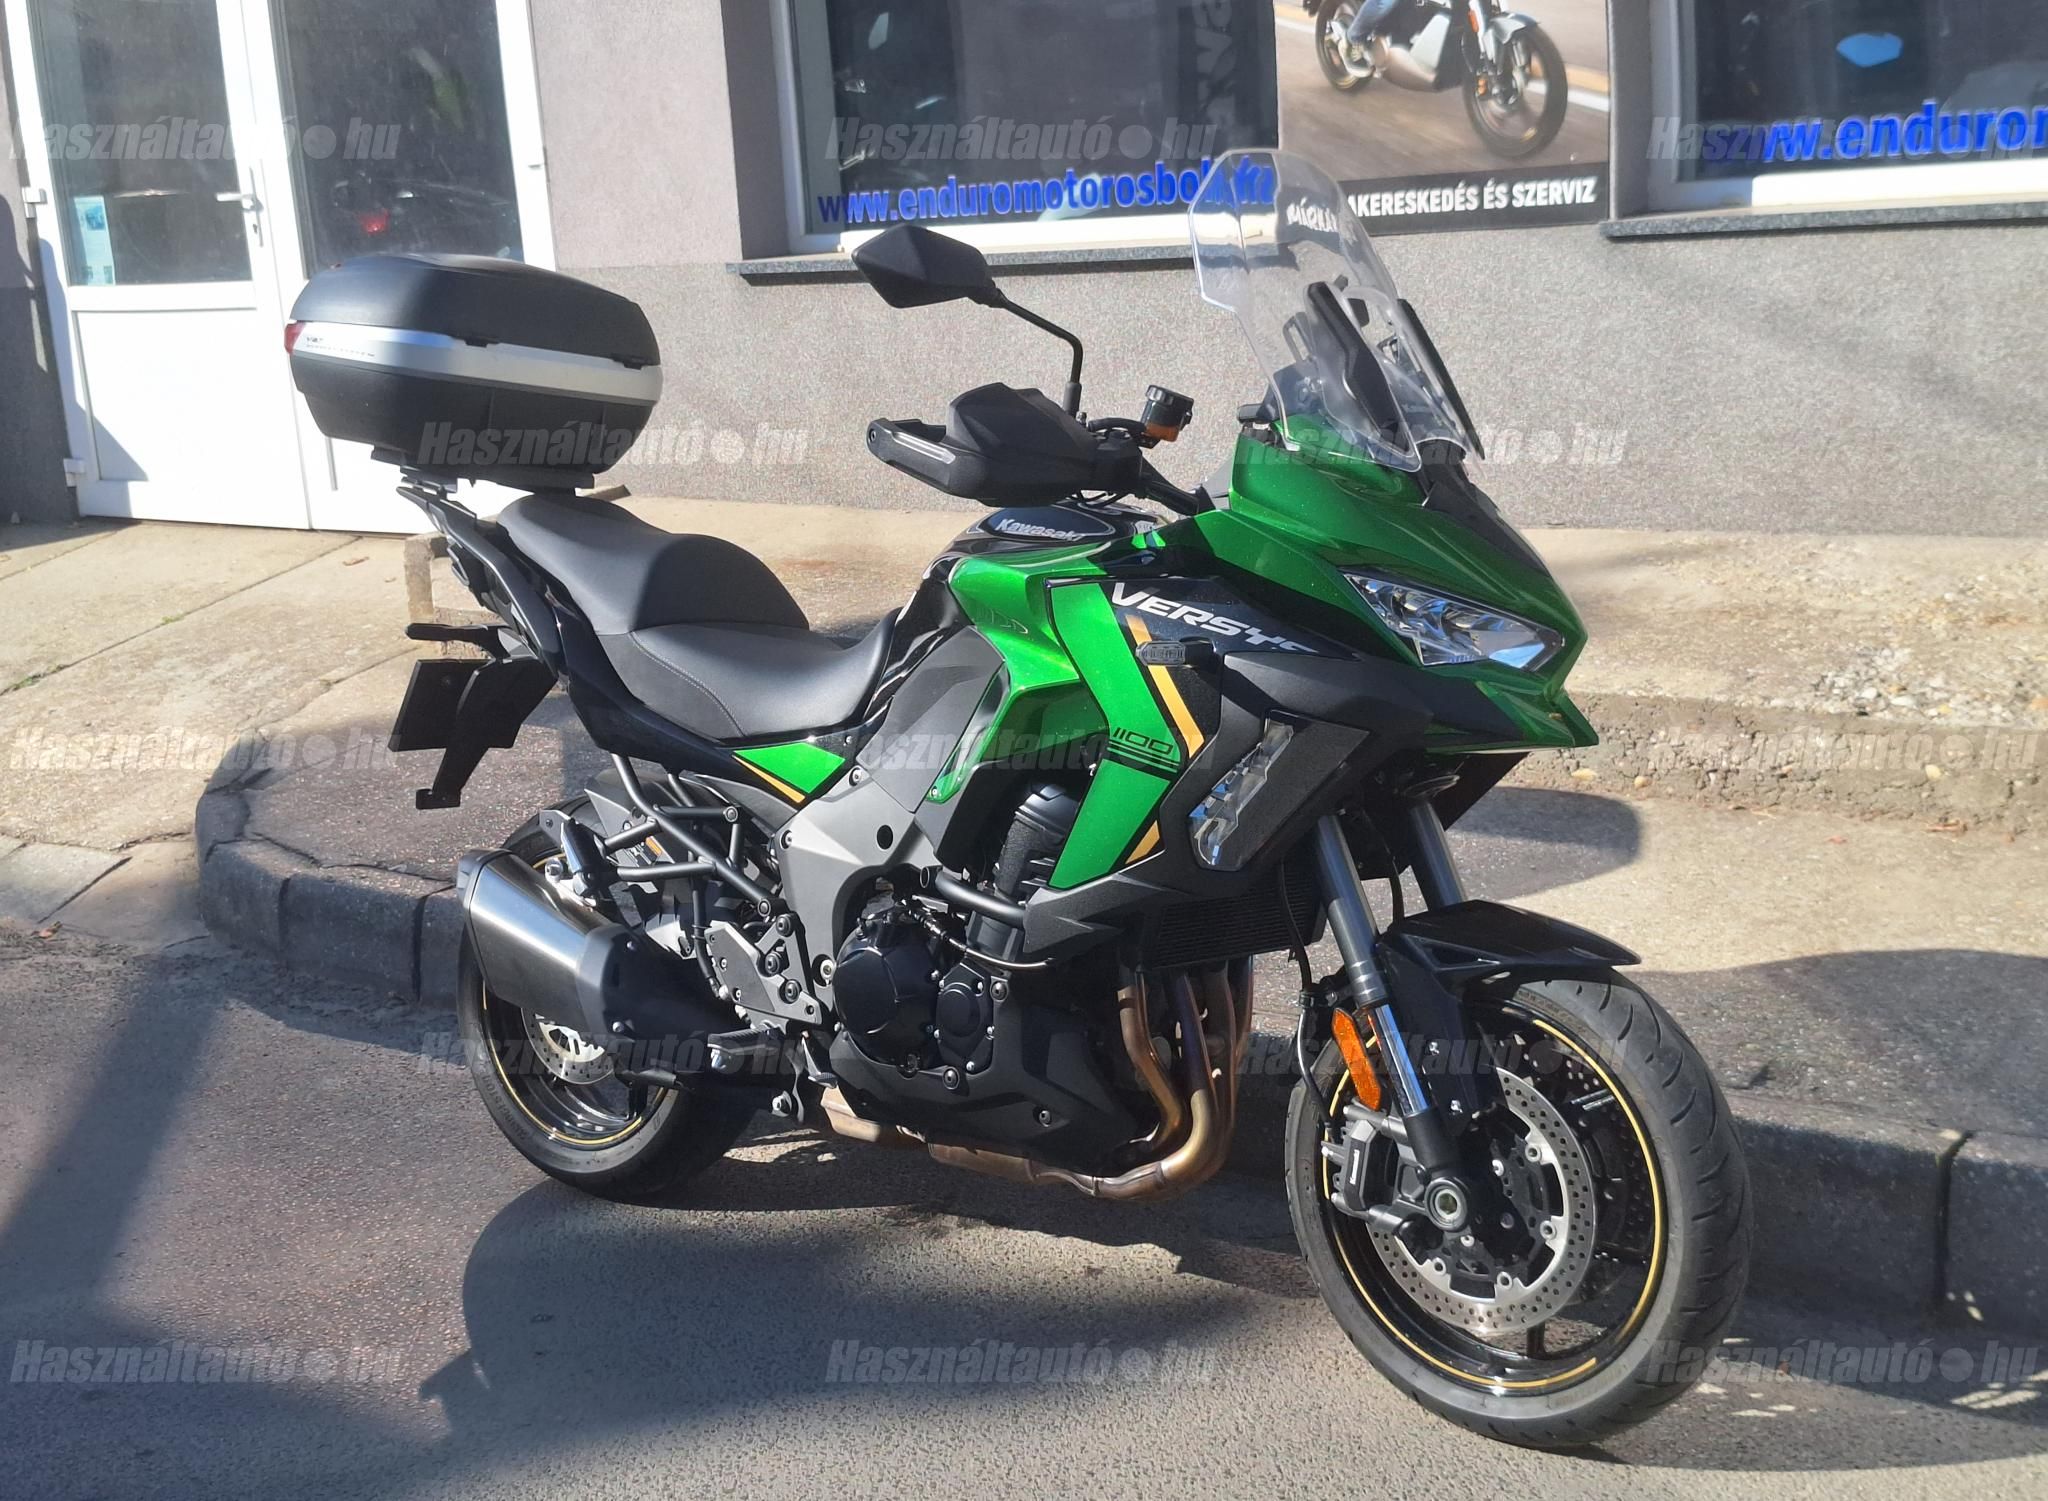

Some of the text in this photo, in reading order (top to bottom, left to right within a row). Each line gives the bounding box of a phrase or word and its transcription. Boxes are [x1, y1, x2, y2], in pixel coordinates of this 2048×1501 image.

[1483, 178, 1511, 209] ÉS
[1512, 176, 1599, 207] SZERVIZ
[995, 518, 1086, 542] Kawasaki
[1112, 727, 1174, 756] 1100
